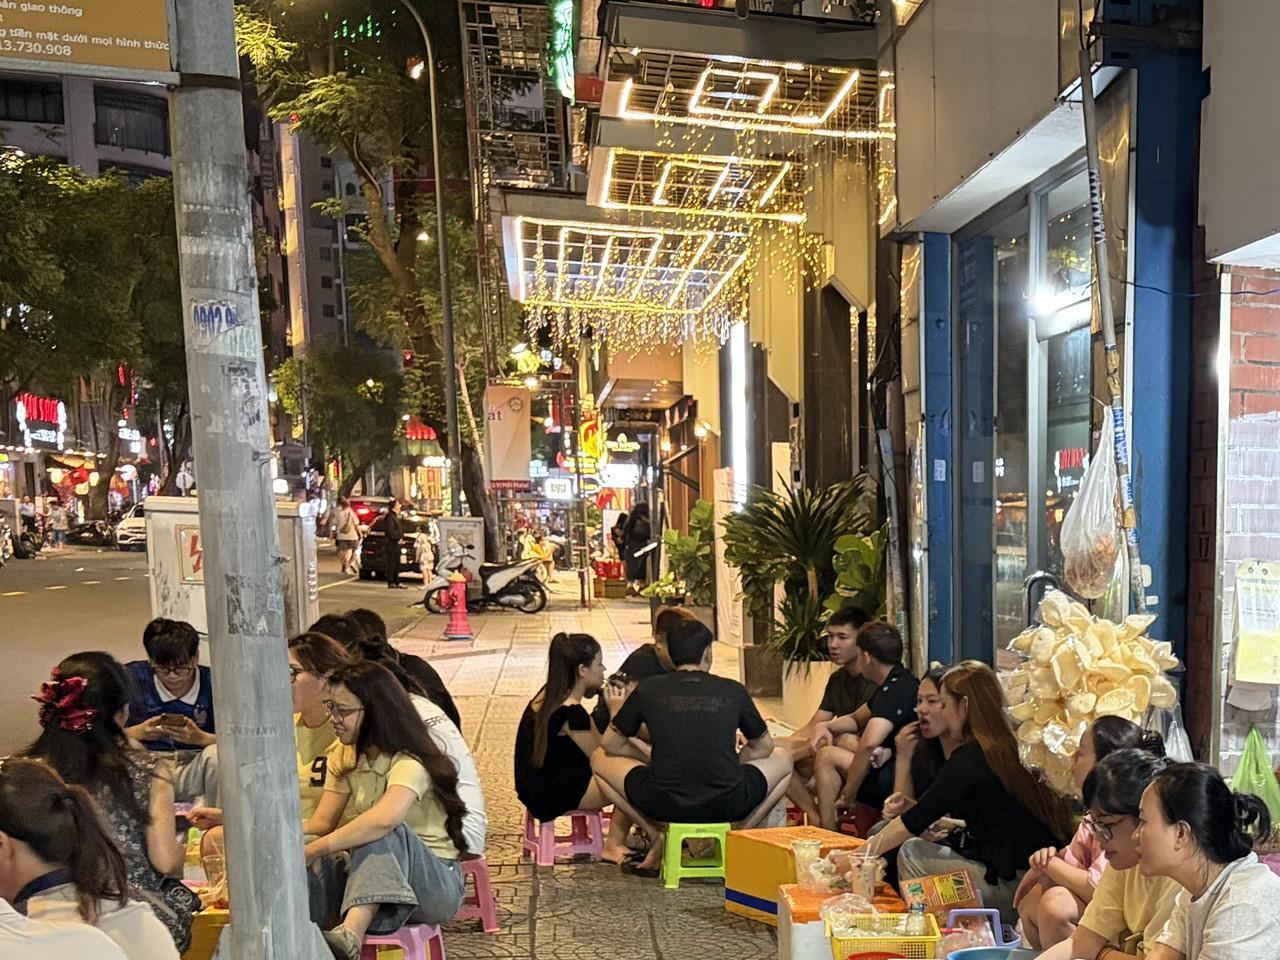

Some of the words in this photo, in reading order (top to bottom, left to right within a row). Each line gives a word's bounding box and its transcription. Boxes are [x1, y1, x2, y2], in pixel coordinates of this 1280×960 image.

[20, 2, 45, 13] giao
[49, 5, 83, 17] thông
[36, 31, 59, 42] mặt
[91, 37, 113, 46] mọi
[116, 38, 140, 48] hình
[309, 756, 328, 788] 9
